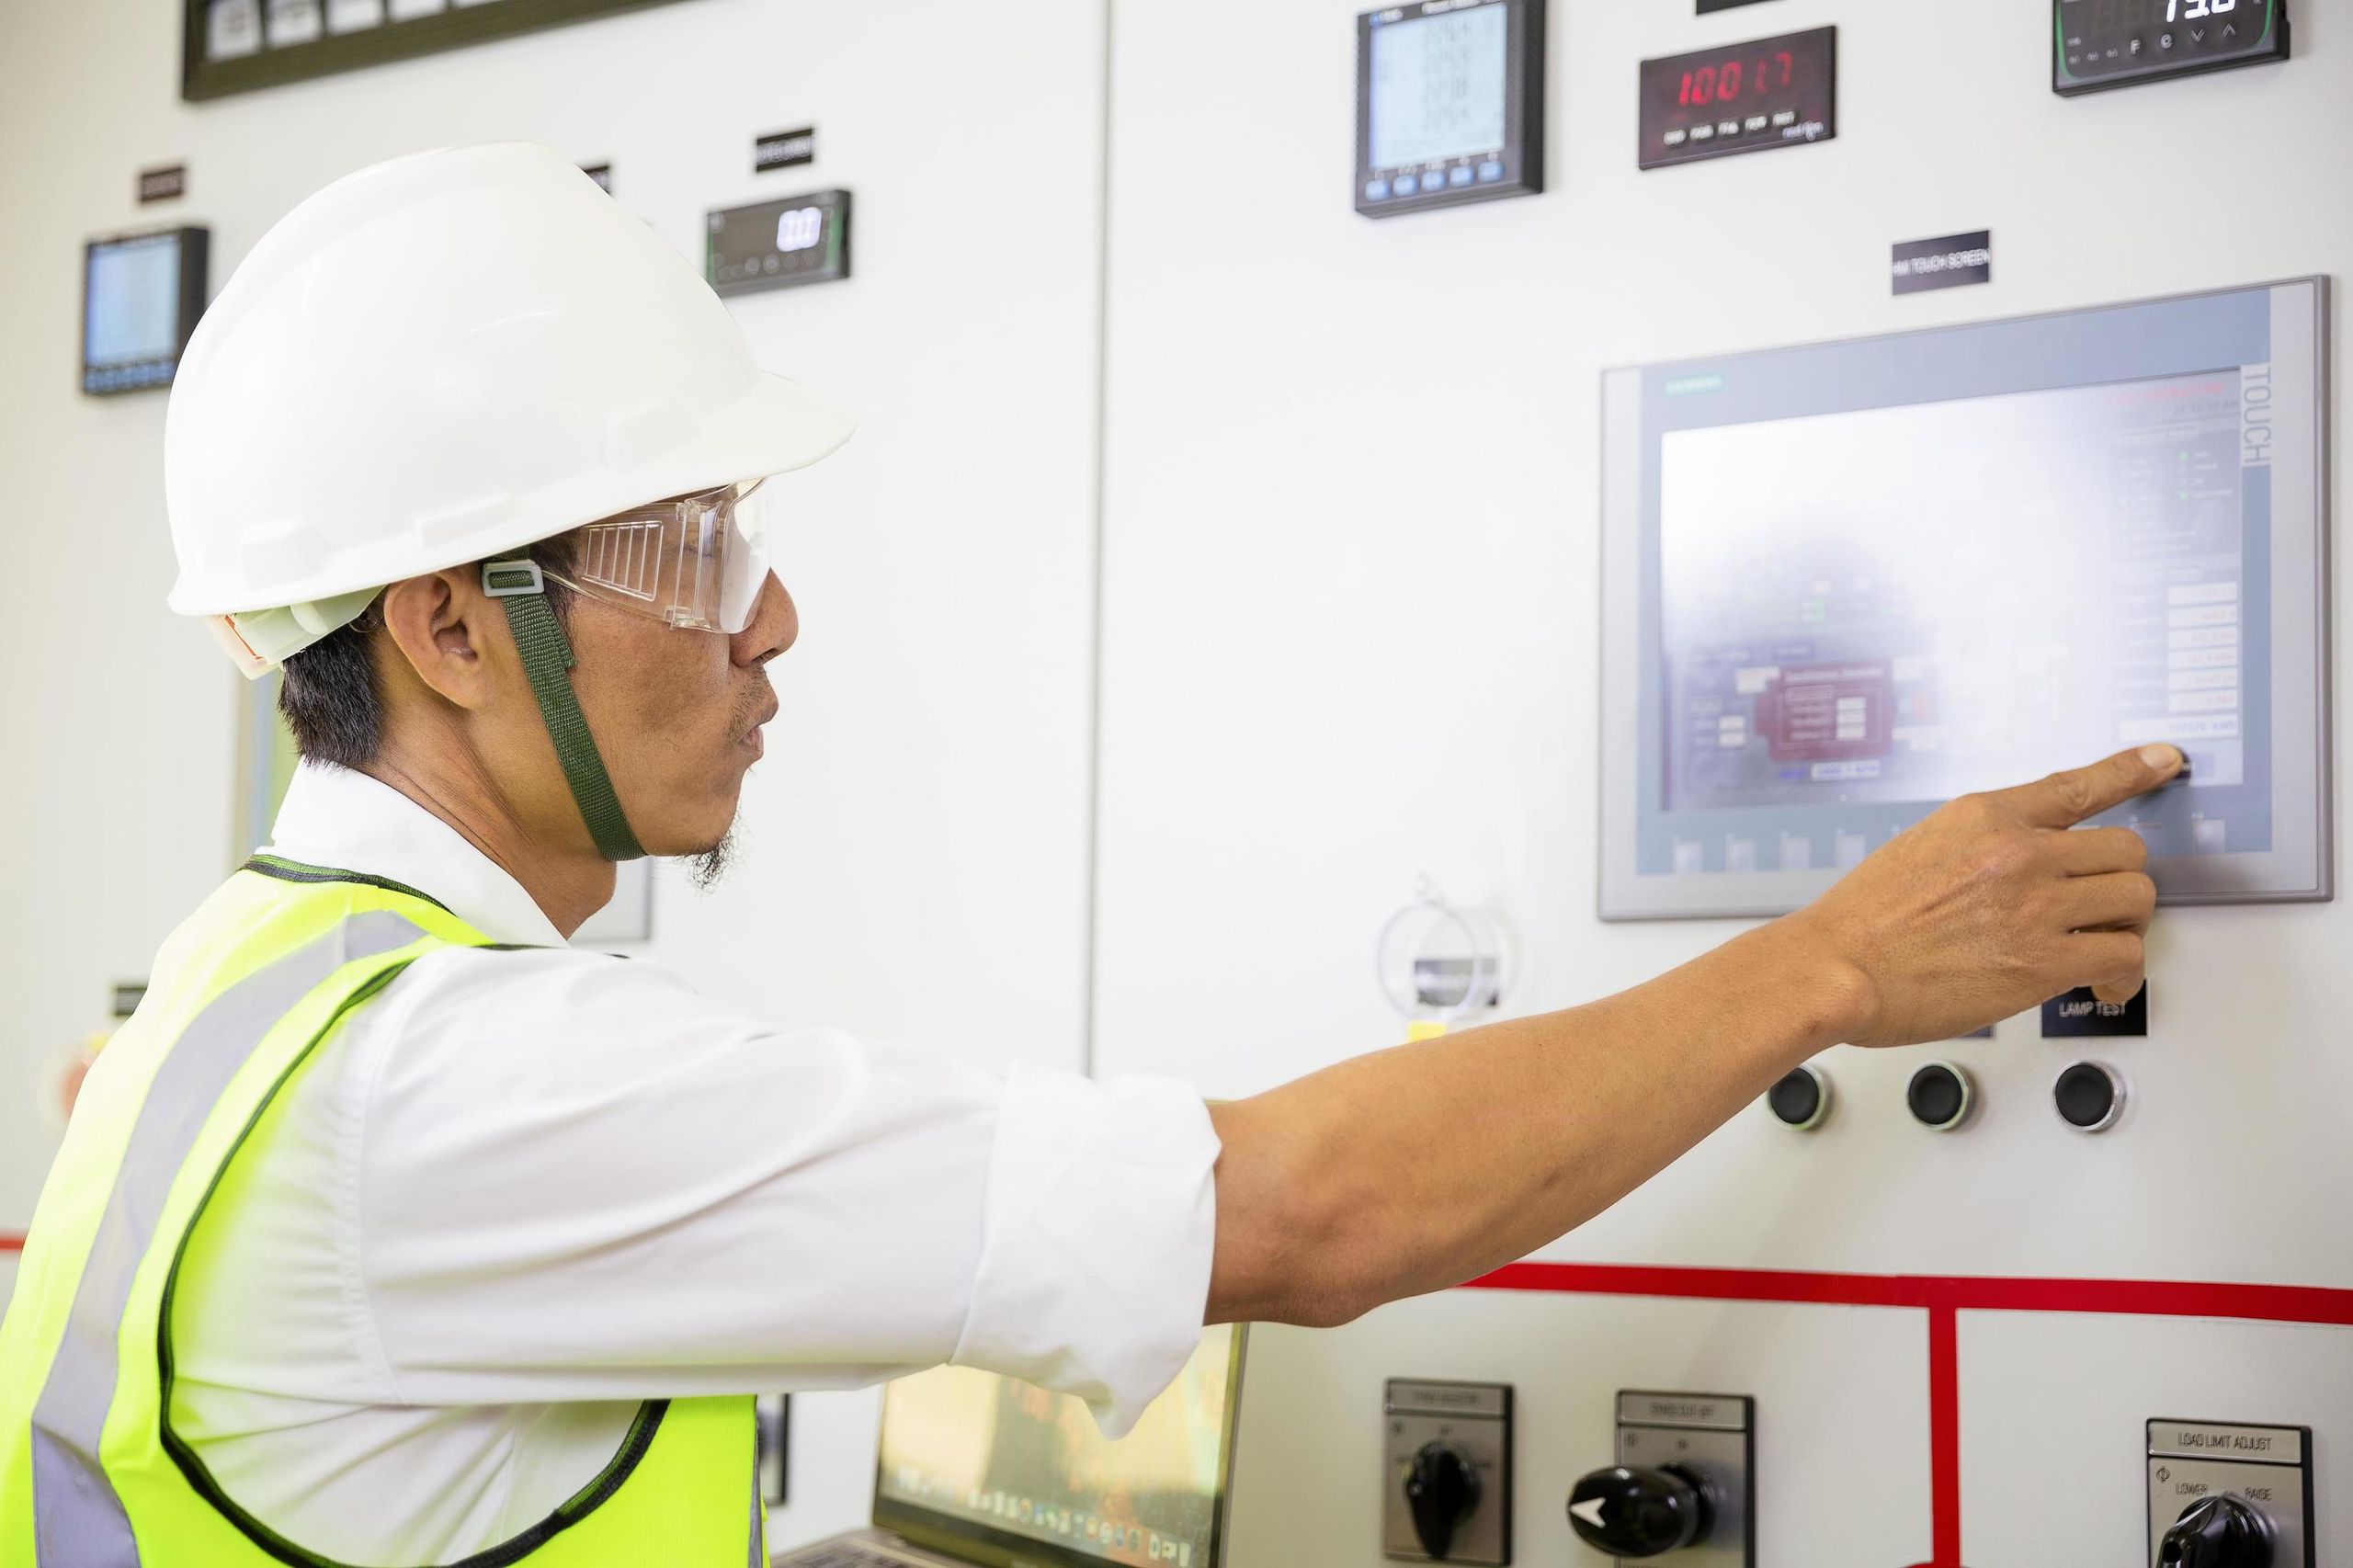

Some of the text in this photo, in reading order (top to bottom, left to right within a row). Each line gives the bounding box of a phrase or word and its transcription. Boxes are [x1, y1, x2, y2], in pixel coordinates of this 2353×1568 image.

[1948, 248, 1989, 269] SCREEN
[2244, 366, 2272, 463] TOUCH
[2059, 1001, 2127, 1018] LAMP TEST
[2178, 1432, 2273, 1451] LOAD LIMIT ADJUST
[2176, 1483, 2273, 1501] LOWER RAISE
